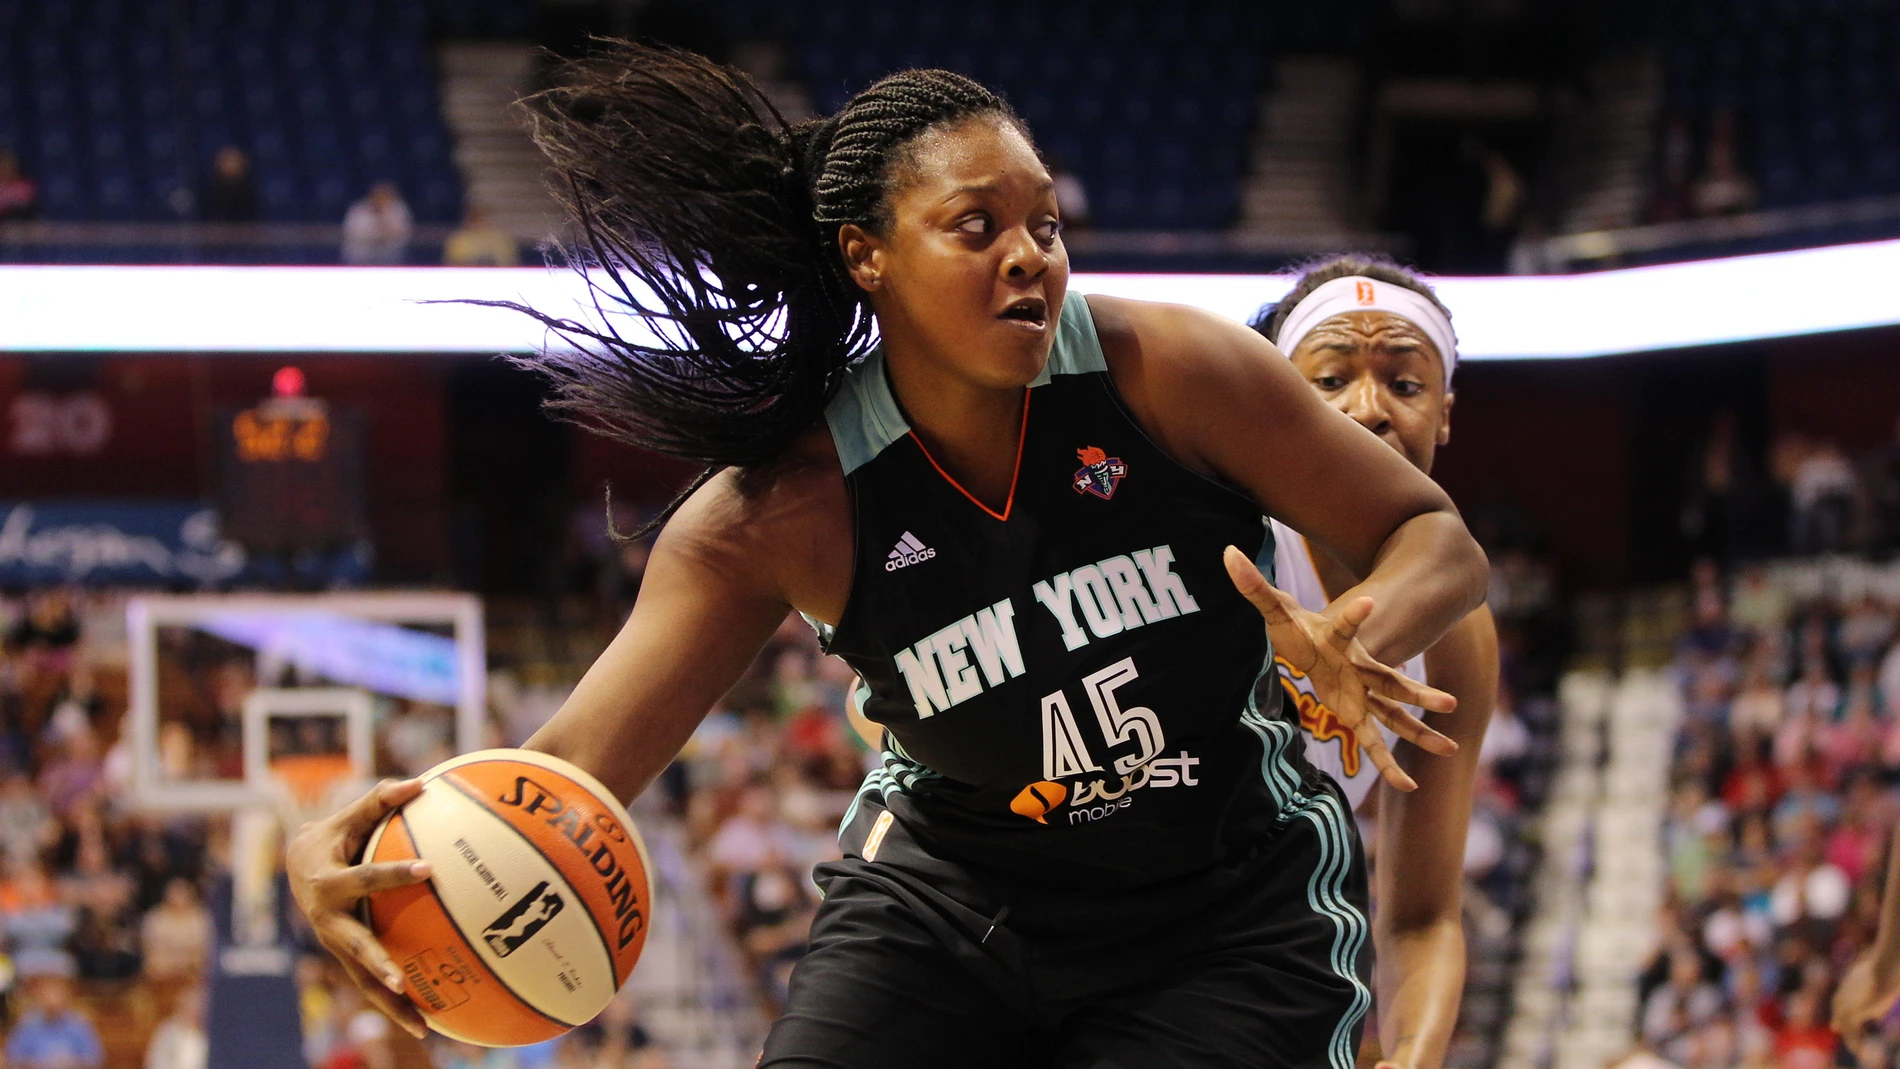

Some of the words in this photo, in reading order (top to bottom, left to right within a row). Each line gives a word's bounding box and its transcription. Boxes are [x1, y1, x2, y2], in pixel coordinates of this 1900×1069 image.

[885, 546, 936, 572] adidas
[894, 597, 1026, 720] NEW
[1032, 544, 1201, 652] YORK
[1041, 656, 1165, 782] 45
[497, 775, 644, 951] SPALDING
